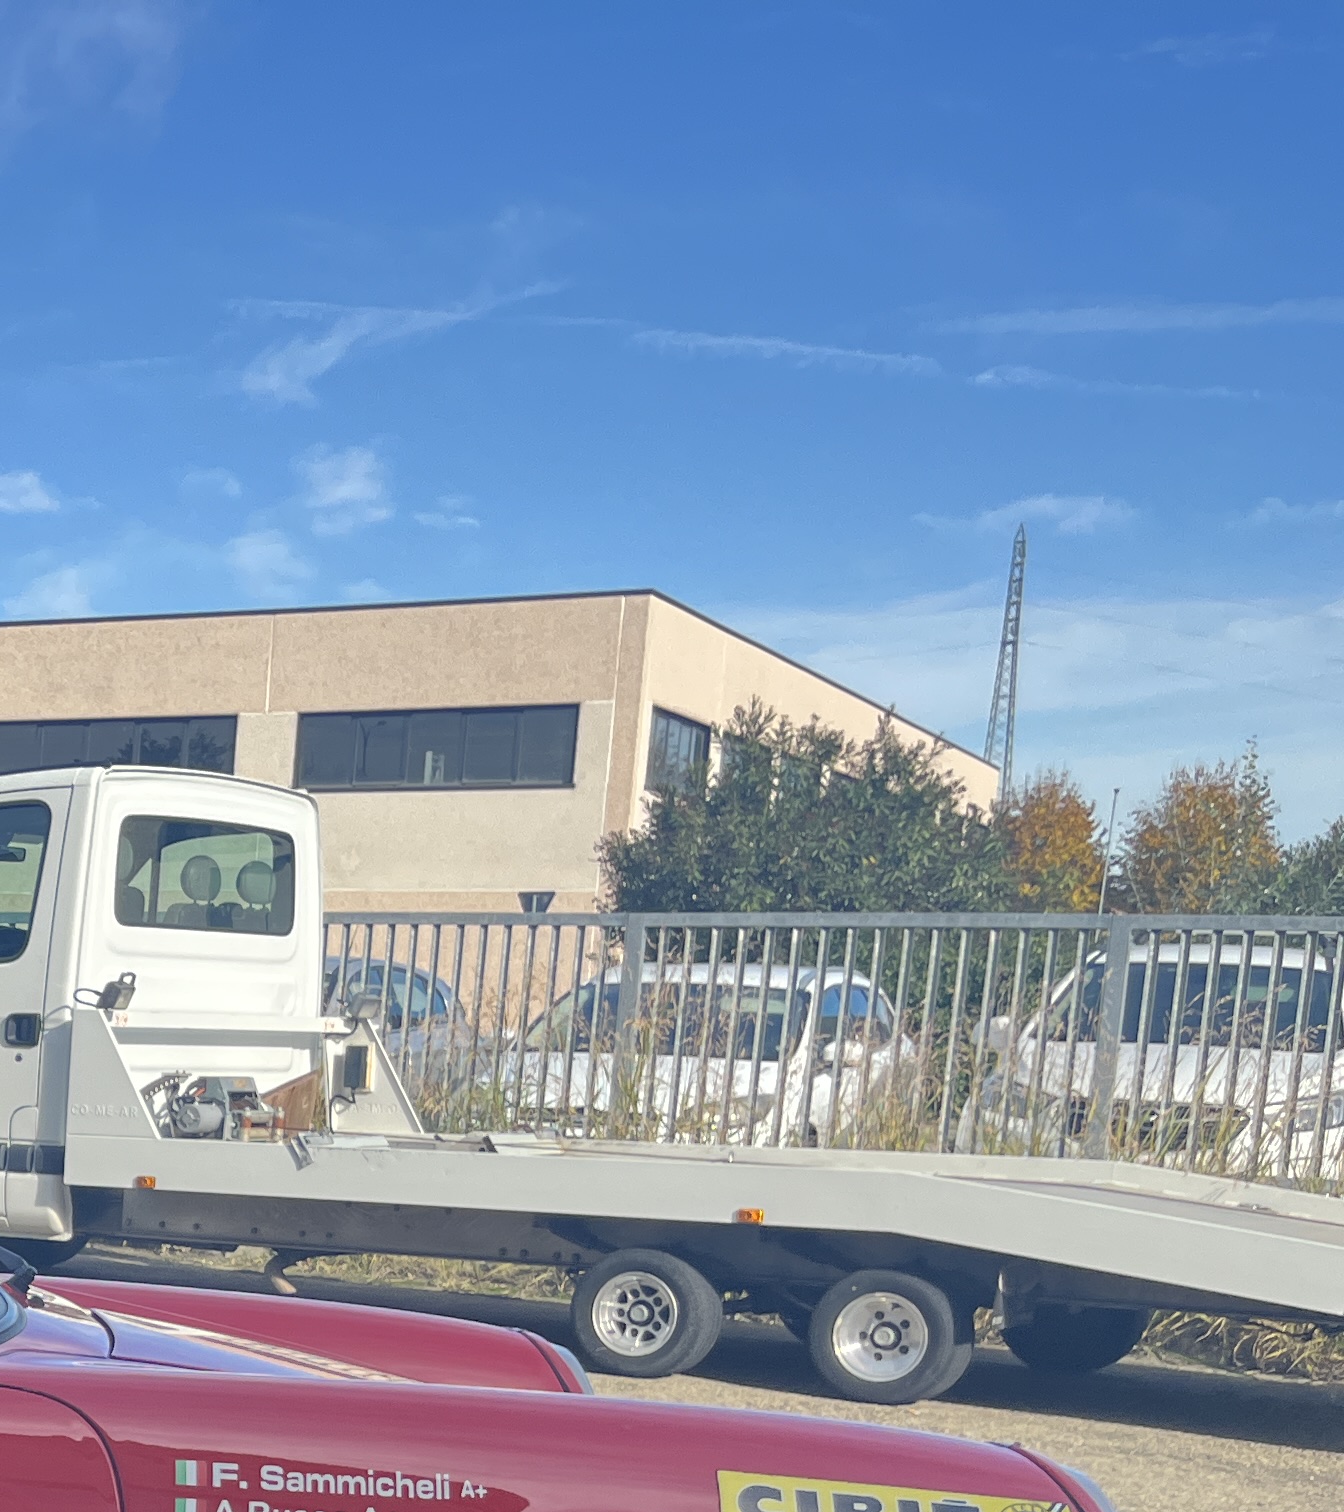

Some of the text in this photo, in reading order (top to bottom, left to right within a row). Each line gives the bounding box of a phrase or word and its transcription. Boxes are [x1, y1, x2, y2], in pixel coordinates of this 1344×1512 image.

[212, 1461, 488, 1500] F. Sammicheli A+
